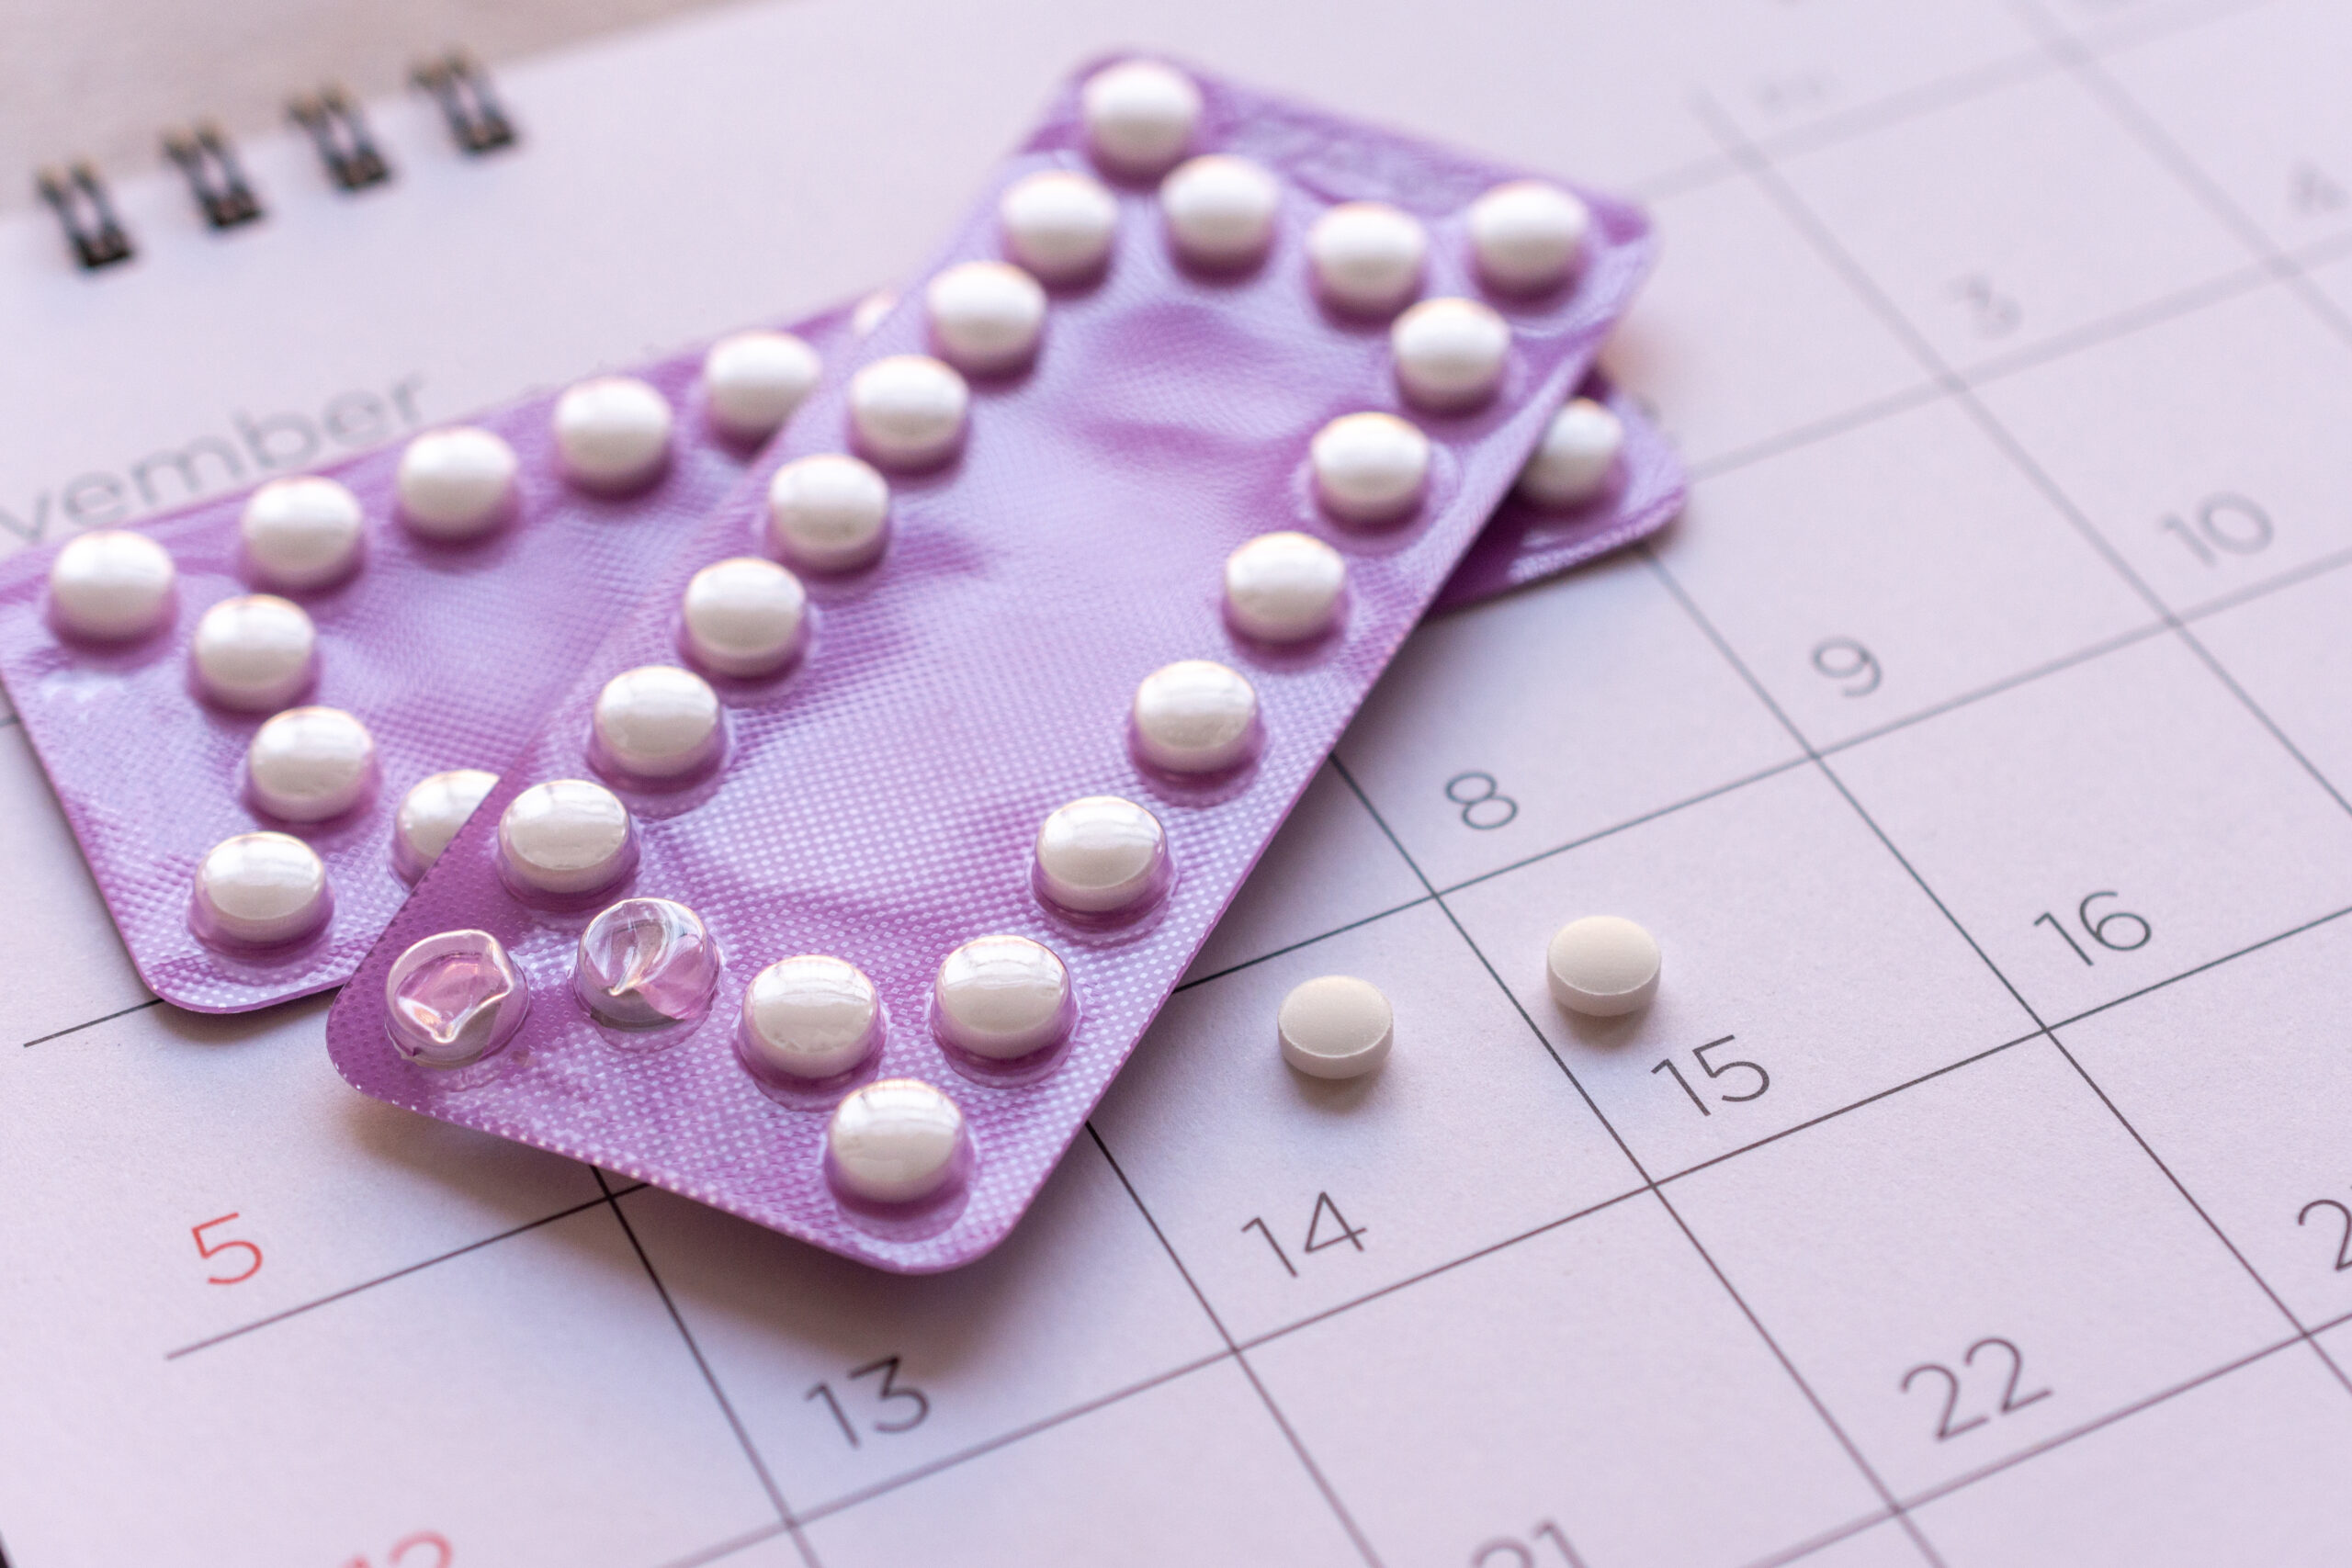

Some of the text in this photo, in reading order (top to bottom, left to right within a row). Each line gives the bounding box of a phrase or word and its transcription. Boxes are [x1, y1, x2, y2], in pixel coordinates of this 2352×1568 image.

[2159, 491, 2274, 568] 10
[1810, 636, 1883, 698] 9
[1445, 771, 1518, 830] 8
[2033, 891, 2152, 967] 16
[1650, 1034, 1770, 1117] 15
[190, 1211, 263, 1285] 5
[1241, 1190, 1367, 1278] 14
[2298, 1182, 2352, 1272] 2
[805, 1355, 931, 1450] 13
[1899, 1337, 2053, 1441] 22
